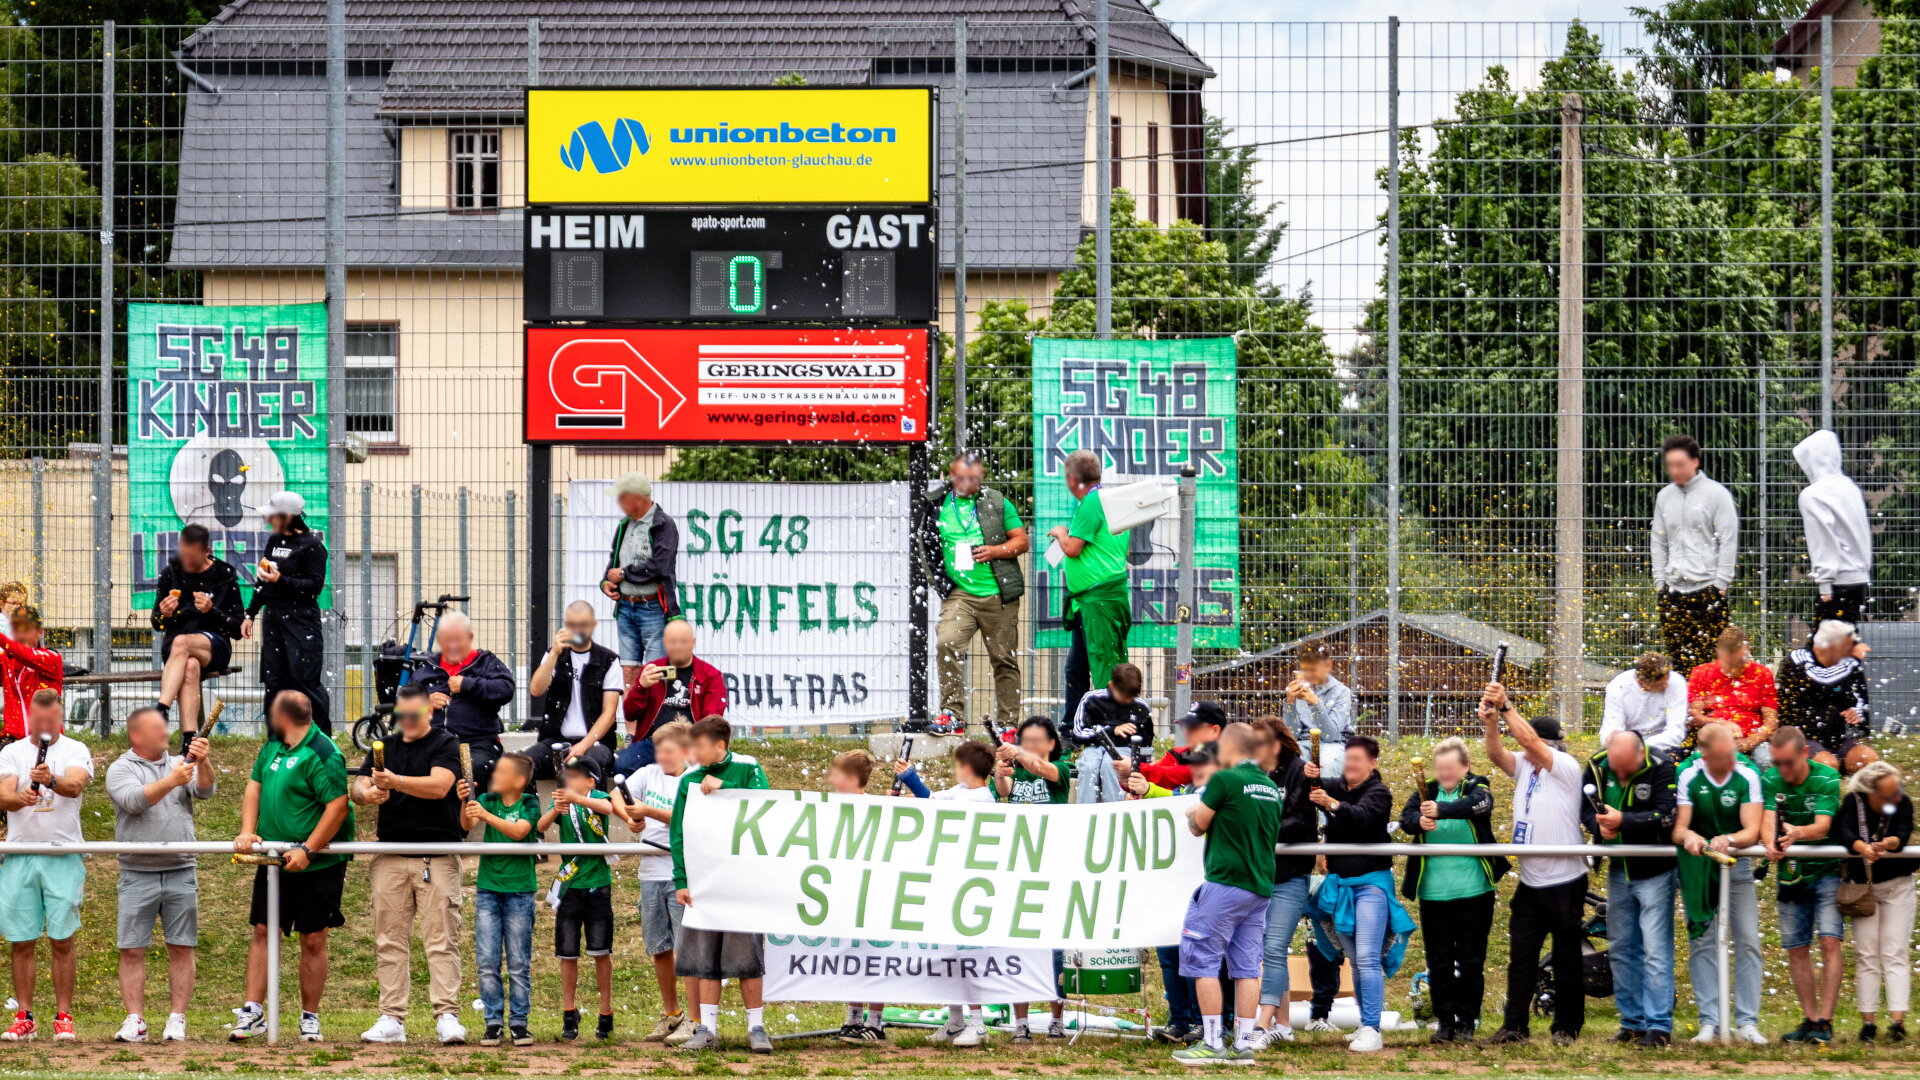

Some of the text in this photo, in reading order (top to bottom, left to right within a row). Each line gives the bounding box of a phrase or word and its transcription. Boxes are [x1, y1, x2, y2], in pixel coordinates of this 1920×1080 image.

[670, 122, 896, 143] unionbeton
[670, 153, 873, 169] www.unionbeton-glauchau.de
[531, 215, 645, 249] HEIM
[691, 215, 766, 230] apato-sport.com
[826, 214, 926, 249] GAST
[728, 255, 762, 312] 0
[156, 323, 299, 381] SG 48
[707, 364, 896, 377] GERINGSWALD
[1060, 357, 1208, 417] SG 48
[138, 379, 317, 440] KINDER
[707, 411, 896, 426] www.geringswald.com
[1043, 415, 1226, 476] KINDER
[272, 547, 292, 557] VANS
[686, 508, 744, 562] SG
[758, 513, 811, 558] 48
[676, 572, 879, 640] HÖNFELS
[723, 671, 869, 714] RULTRAS
[730, 791, 1177, 874] KÄMPFEN UND
[796, 865, 1128, 940] SIEGEN!
[788, 954, 1023, 978] KINDERULTRAS
[1089, 954, 1139, 966] SCHÖNFELS
